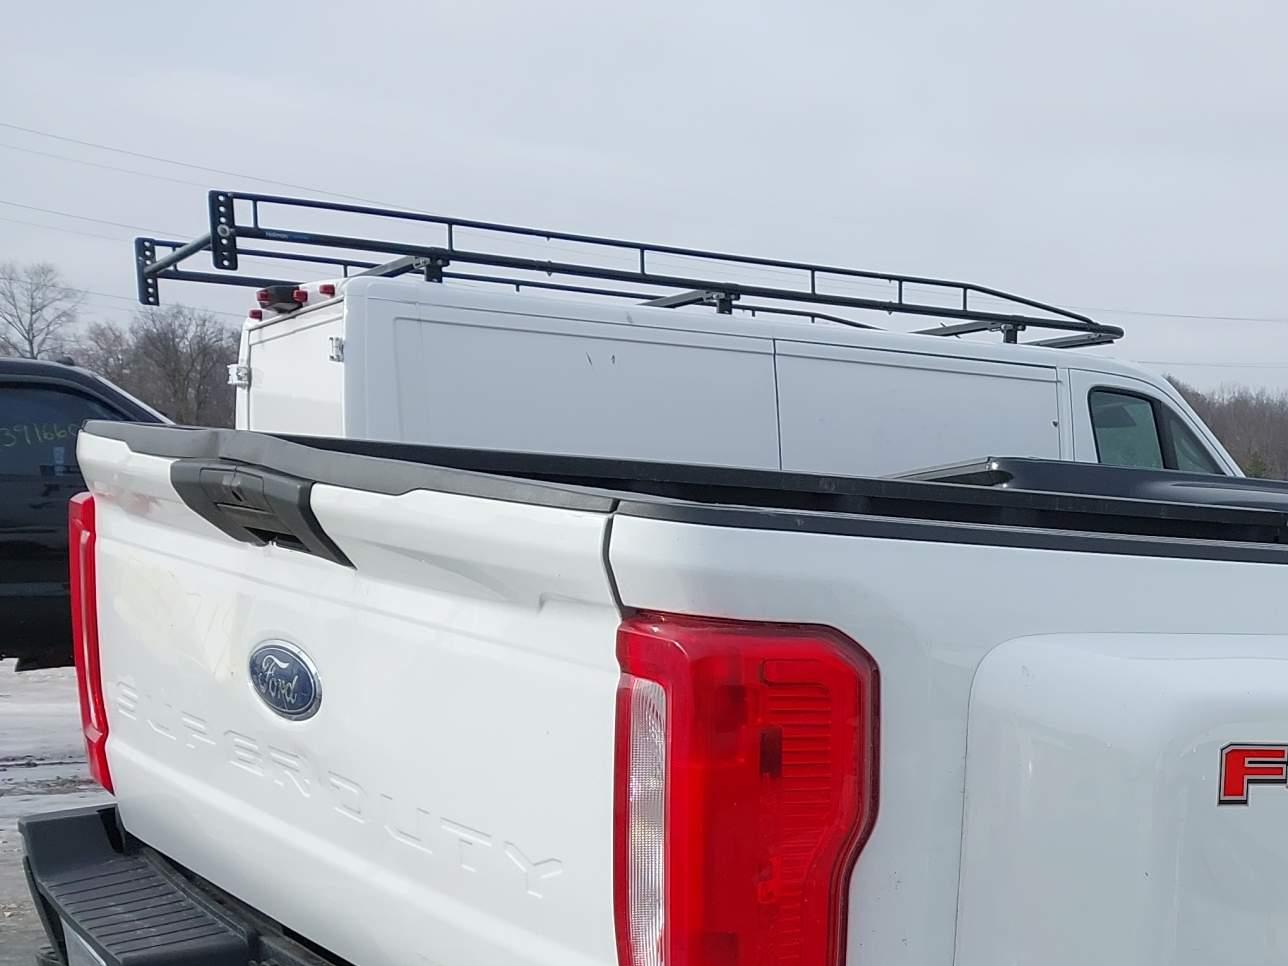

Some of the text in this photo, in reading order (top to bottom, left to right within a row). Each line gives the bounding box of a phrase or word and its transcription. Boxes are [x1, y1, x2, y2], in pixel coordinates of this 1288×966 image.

[258, 654, 299, 708] Ford
[116, 681, 564, 899] SUPER DUTY
